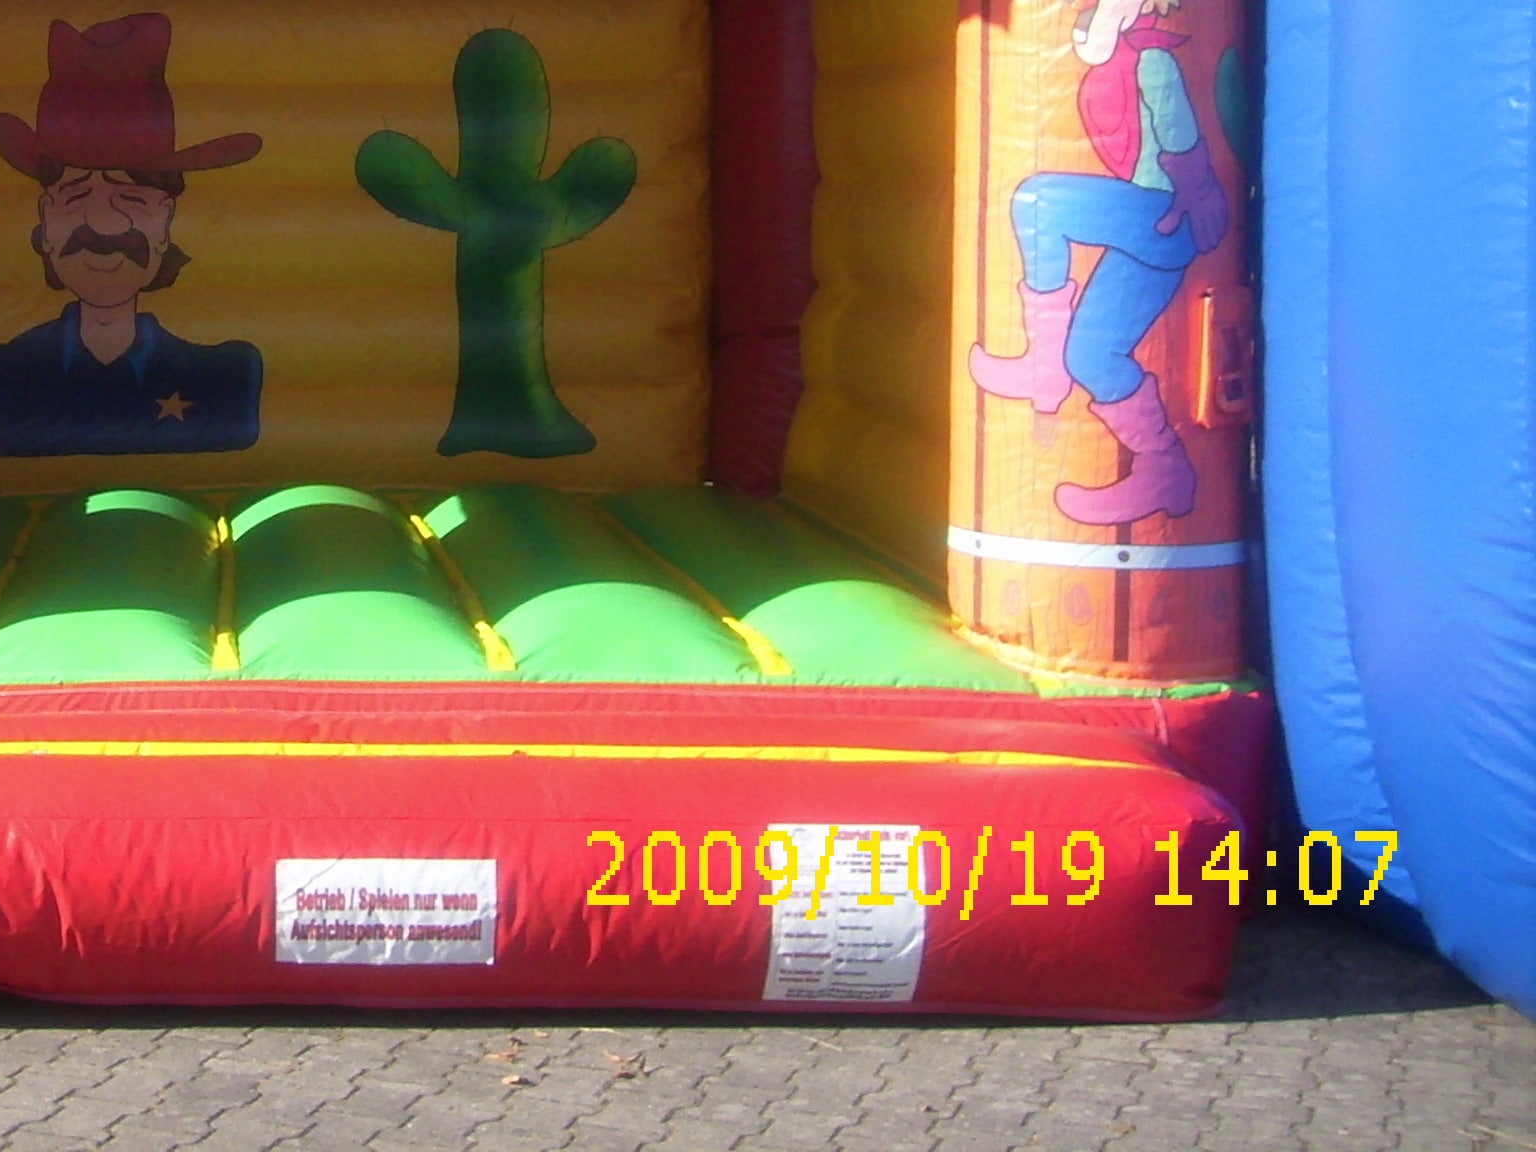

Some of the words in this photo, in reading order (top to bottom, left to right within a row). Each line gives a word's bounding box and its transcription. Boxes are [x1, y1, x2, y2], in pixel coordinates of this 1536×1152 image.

[296, 888, 346, 911] Betrieb
[358, 887, 410, 916] Spielen
[414, 893, 438, 911] nur
[442, 893, 478, 911] wenn
